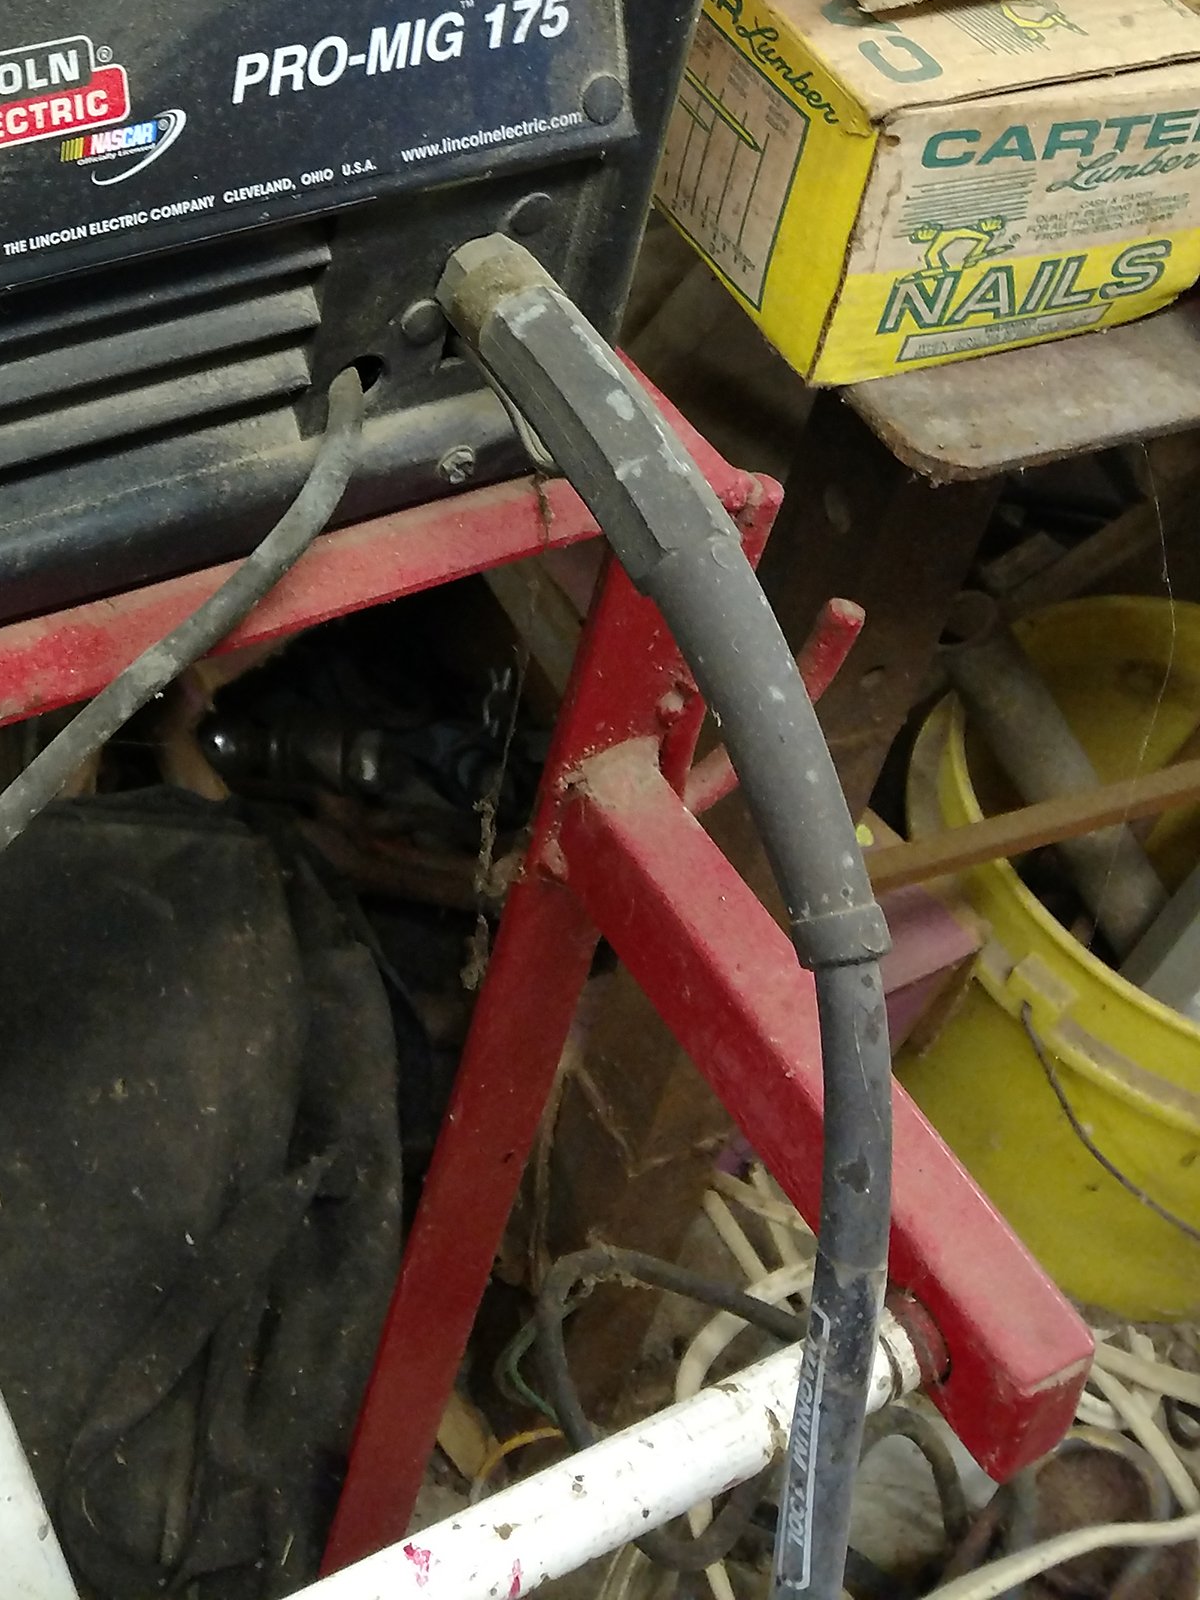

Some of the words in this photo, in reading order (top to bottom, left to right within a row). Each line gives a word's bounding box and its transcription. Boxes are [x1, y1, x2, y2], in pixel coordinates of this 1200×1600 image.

[231, 11, 465, 105] PRO-MIG
[736, 16, 840, 125] Lumber
[90, 122, 154, 155] NASCAR
[401, 111, 583, 164] www.lincolnelectric.com
[921, 108, 1200, 168] CARTE
[1046, 146, 1200, 192] Lumber
[3, 239, 28, 257] THE
[29, 225, 87, 250] LINCOLN
[89, 211, 149, 237] ELECTRIC
[150, 195, 215, 221] COMPANY
[223, 177, 296, 204] CLEVELAND,
[300, 168, 334, 187] OHIO
[341, 159, 377, 177] U.S.A.
[876, 240, 1172, 335] NAILS
[793, 1336, 818, 1472] MAGNUM
